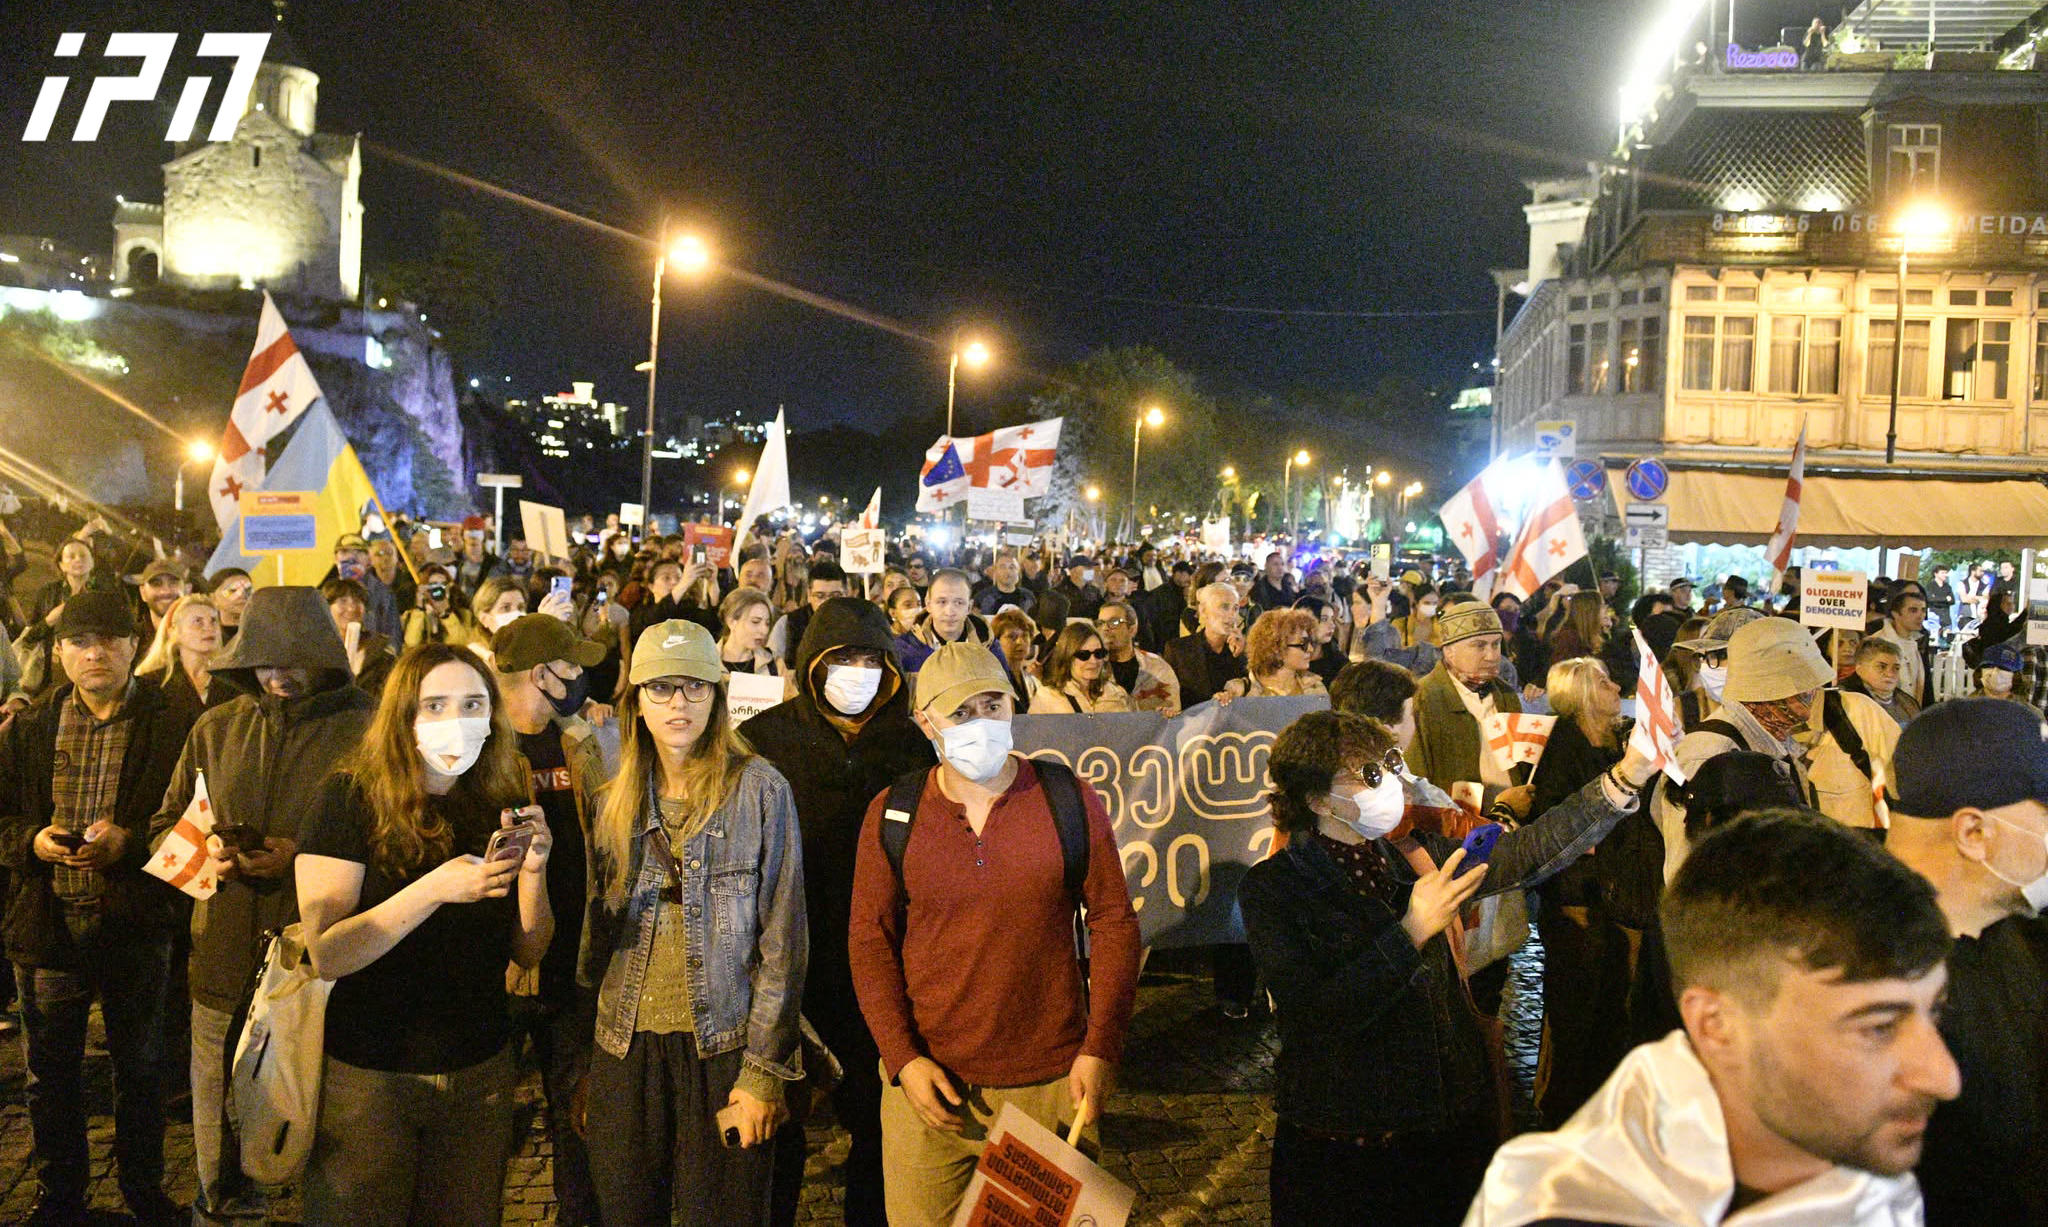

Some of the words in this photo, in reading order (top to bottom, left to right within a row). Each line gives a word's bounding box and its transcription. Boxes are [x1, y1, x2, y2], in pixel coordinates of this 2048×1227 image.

[1806, 588, 1863, 600] OLIGARCHY
[1819, 598, 1846, 607] OVER
[1805, 606, 1863, 618] DEMOCRACY
[1003, 1143, 1073, 1200] CAMPAIGNS
[986, 1152, 1067, 1216] INTIMIDATION
